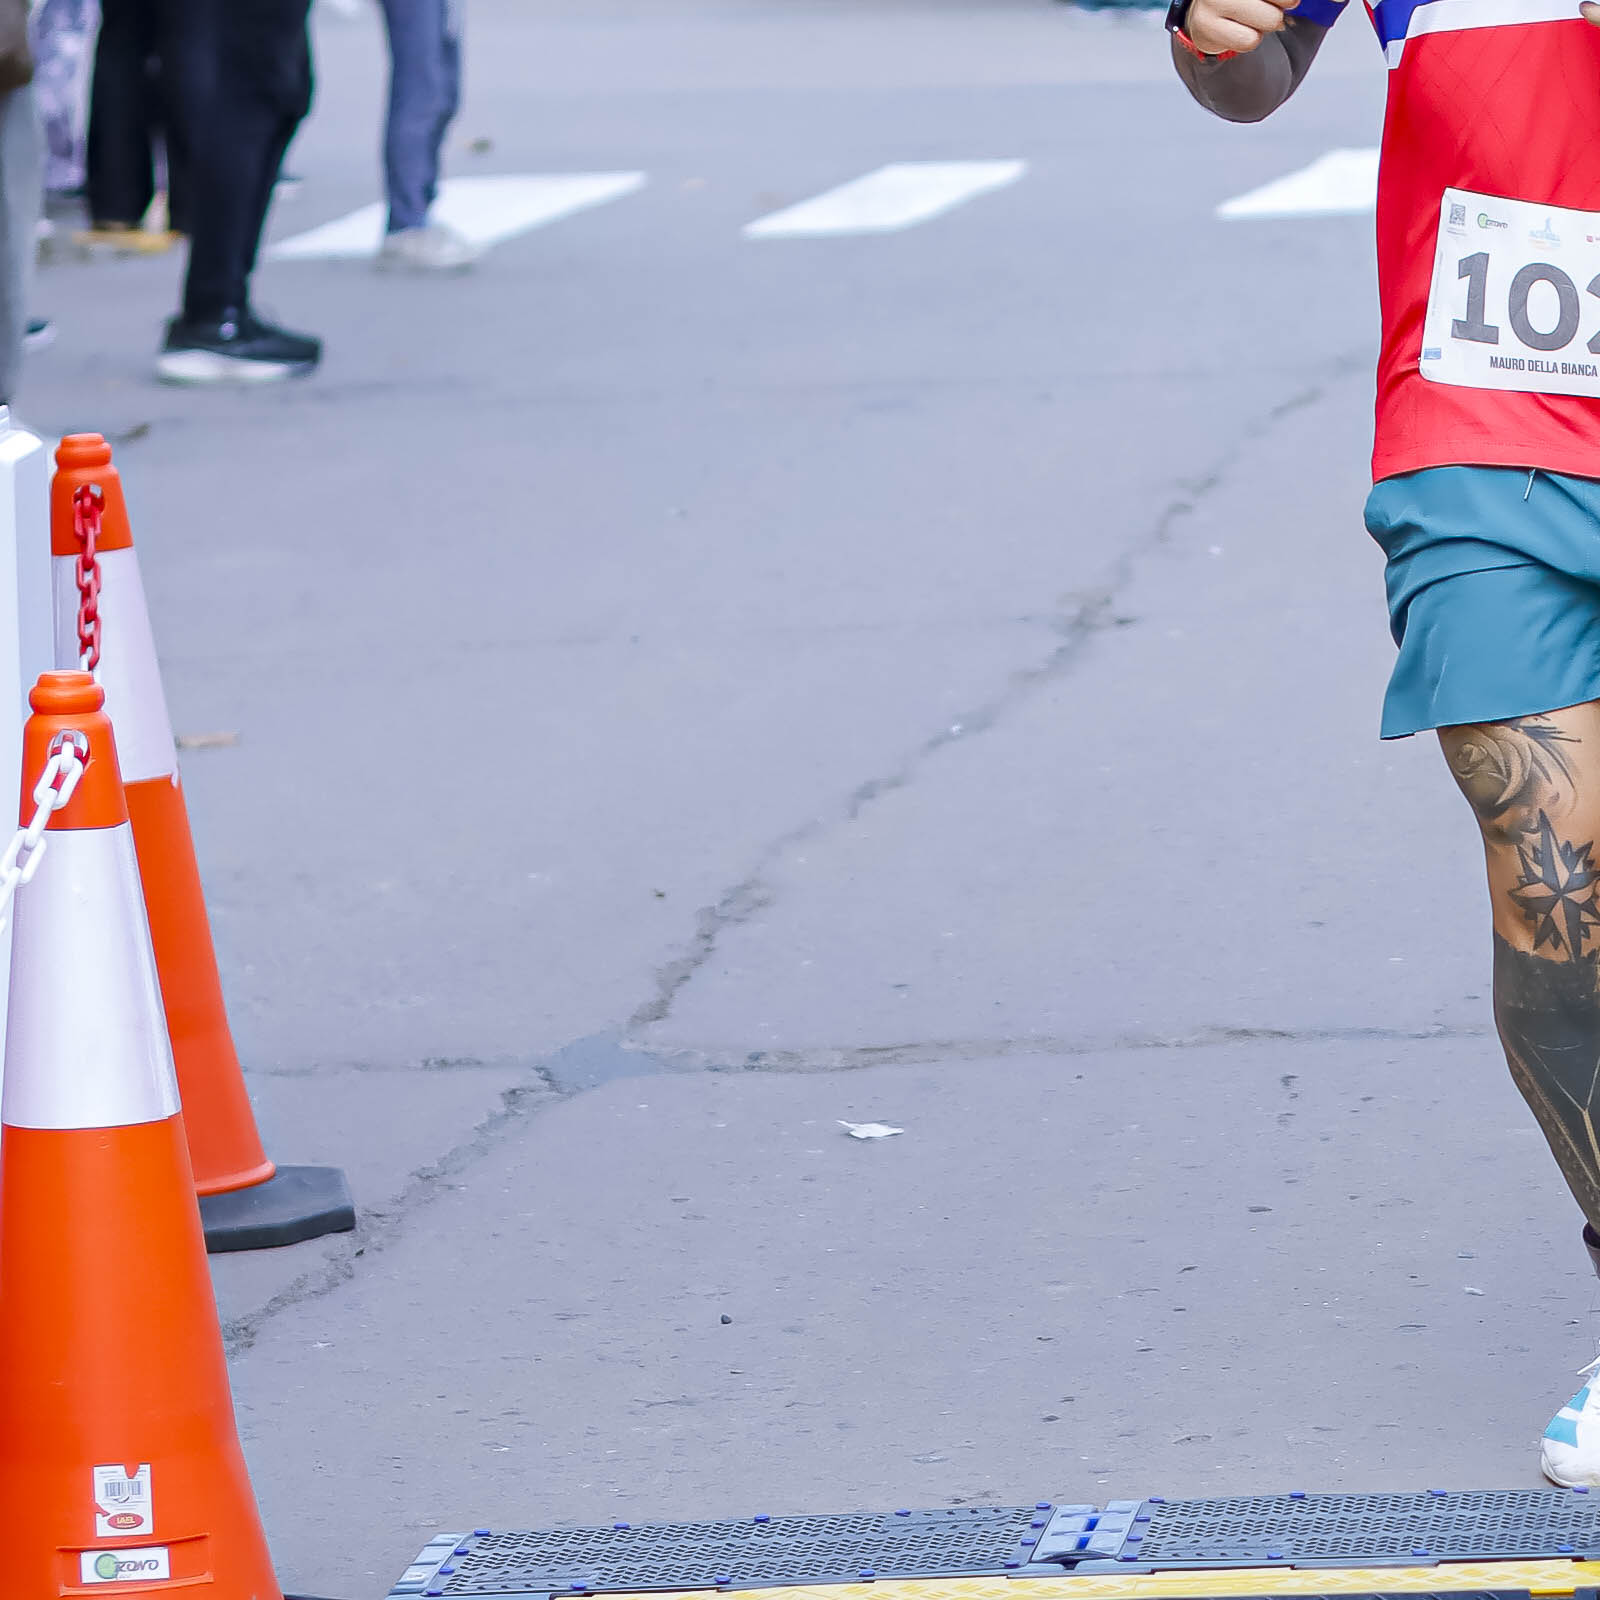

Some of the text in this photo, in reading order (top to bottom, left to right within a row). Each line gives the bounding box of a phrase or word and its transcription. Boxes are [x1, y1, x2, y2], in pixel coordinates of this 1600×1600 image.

[1490, 356, 1598, 377] MAURO DELLA BIANCA
